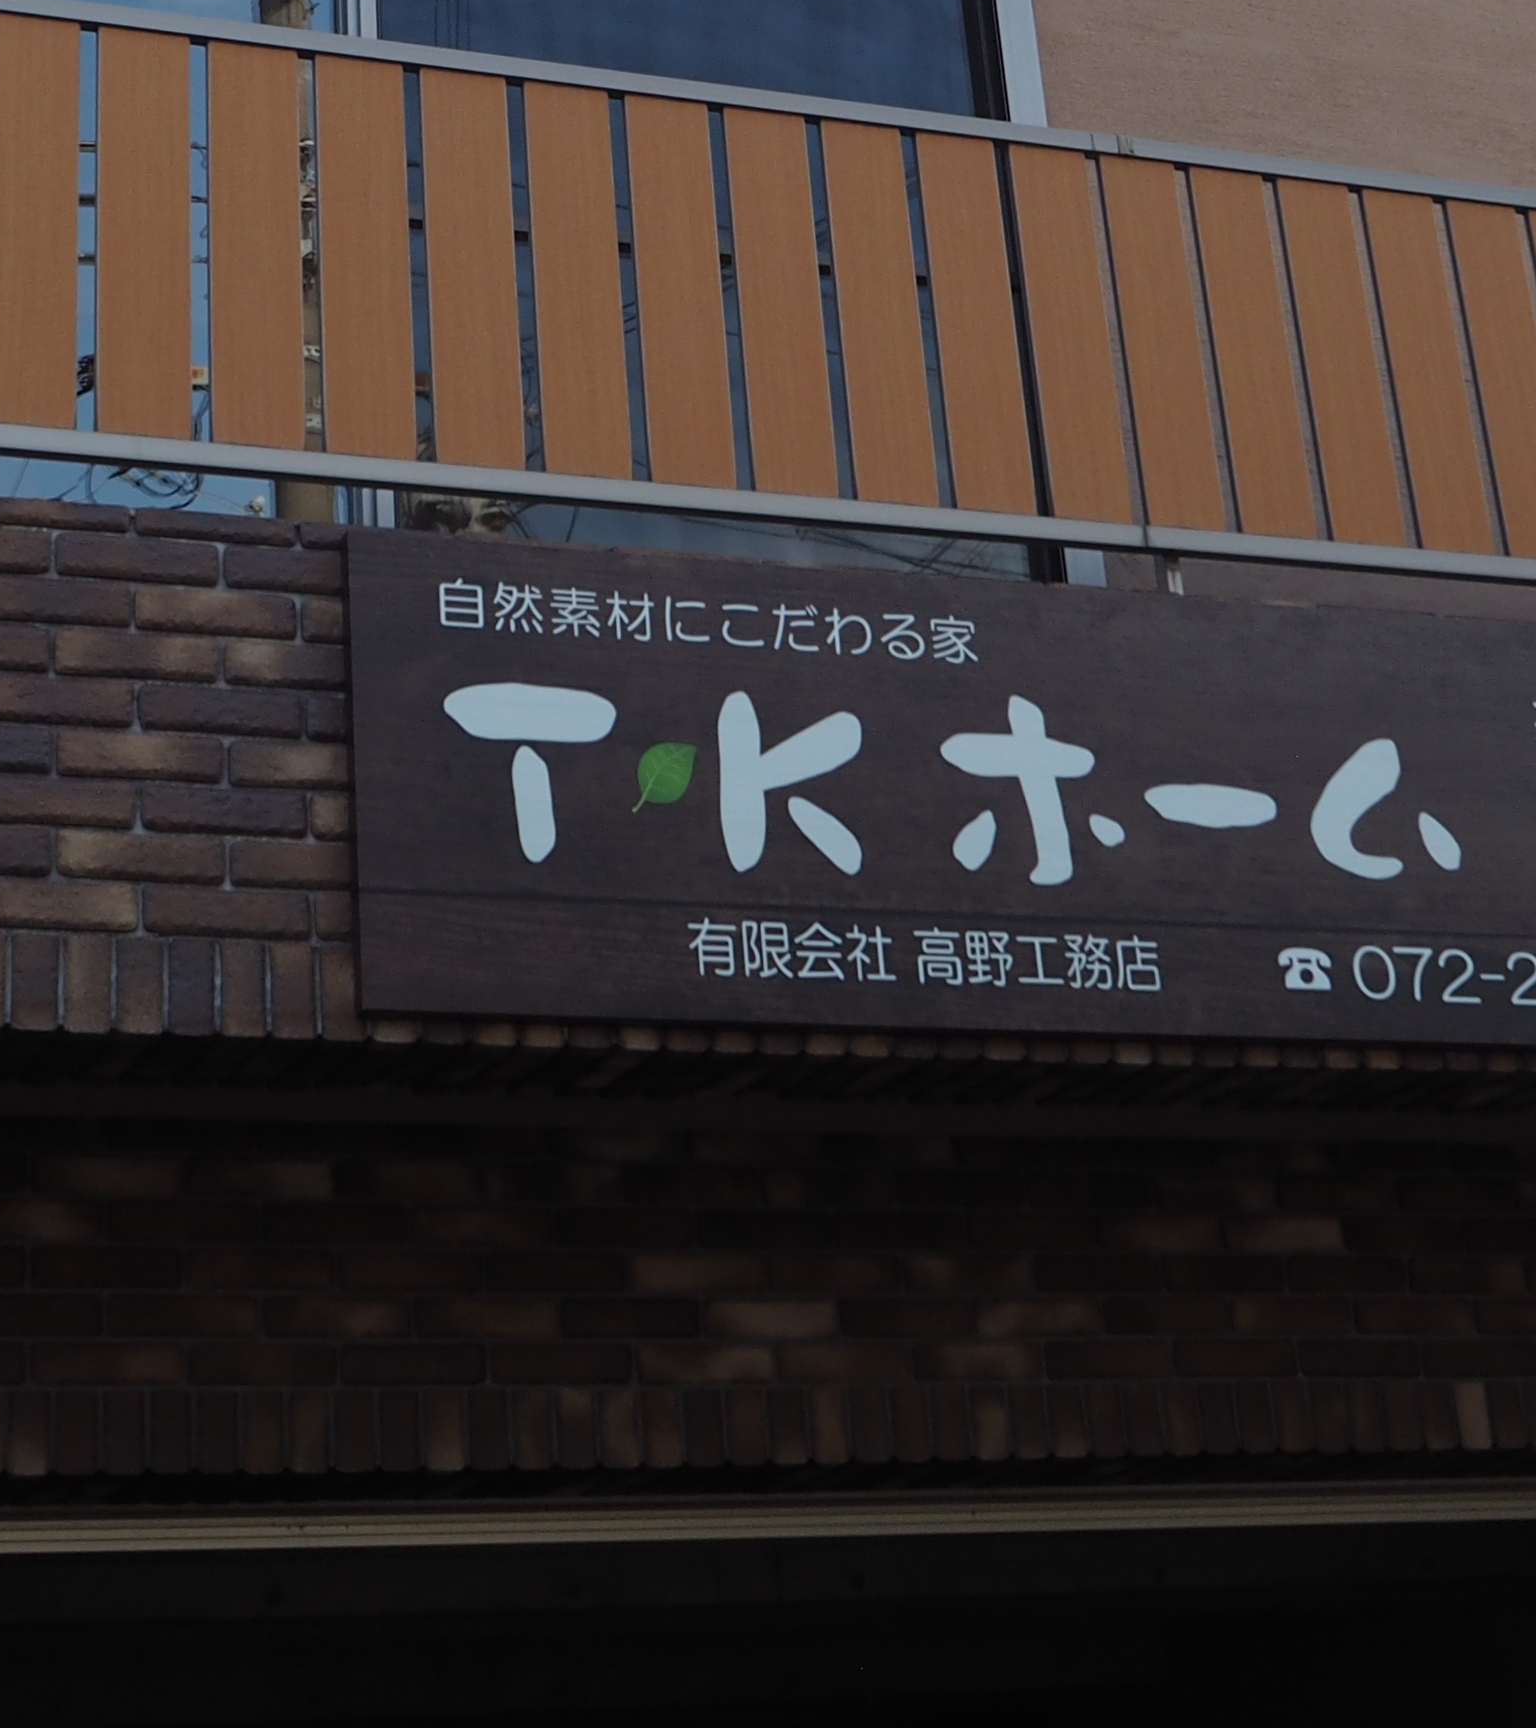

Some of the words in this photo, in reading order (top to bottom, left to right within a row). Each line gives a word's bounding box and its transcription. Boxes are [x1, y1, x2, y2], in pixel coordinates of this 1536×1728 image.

[438, 577, 979, 664] 自然素材にこだわる家
